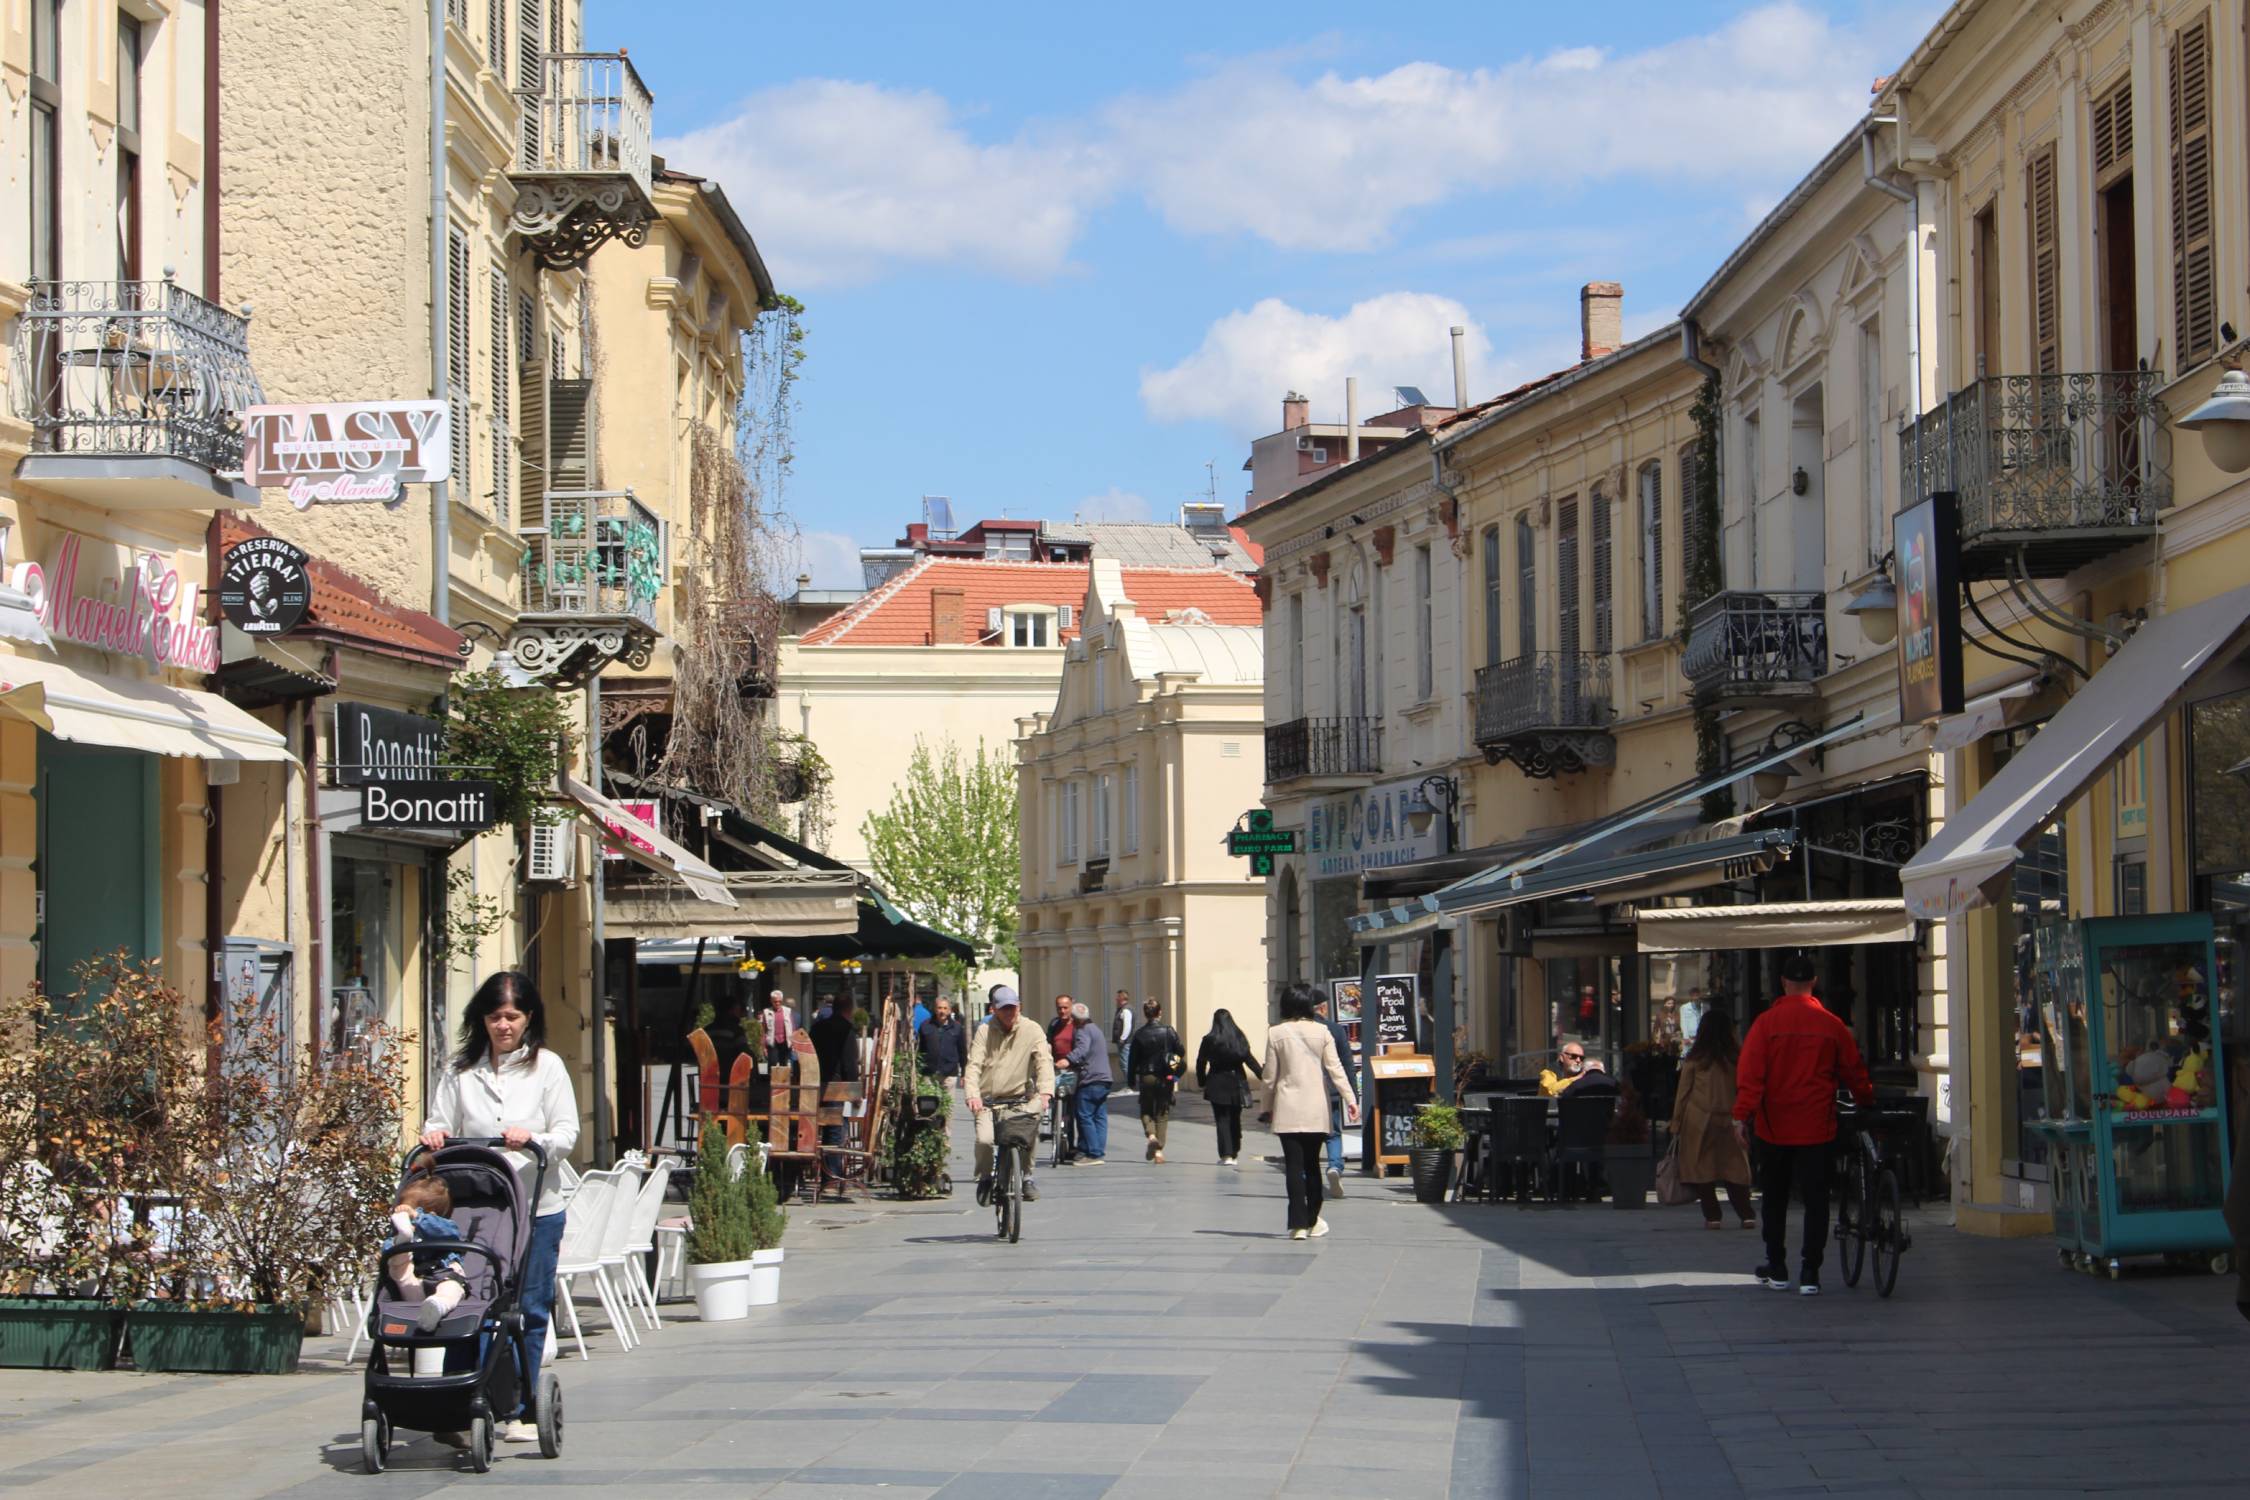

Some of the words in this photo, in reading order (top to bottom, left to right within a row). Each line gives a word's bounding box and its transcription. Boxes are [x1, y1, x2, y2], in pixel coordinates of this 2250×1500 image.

[248, 411, 443, 474] TASY
[282, 443, 337, 452] GUEST
[349, 441, 404, 450] HOUSE
[291, 478, 312, 502] by
[321, 475, 391, 497] Marieli
[228, 550, 239, 559] LA
[238, 539, 289, 555] RESERVA
[289, 550, 300, 559] DE
[227, 553, 299, 583] ¡TIERRA!
[24, 531, 147, 656] Marieli
[147, 552, 220, 675] Cakes
[361, 712, 439, 780] Bonatti
[367, 786, 485, 822] Bonatti
[1235, 832, 1290, 841] PHARMACY
[1234, 845, 1261, 853] EURO
[1264, 844, 1293, 852] FARM
[1381, 996, 1405, 1007] Food
[1389, 1006, 1397, 1015] &
[1379, 1023, 1407, 1032] Rooms
[2130, 1110, 2162, 1120] DOLL
[2165, 1108, 2199, 1118] PARK
